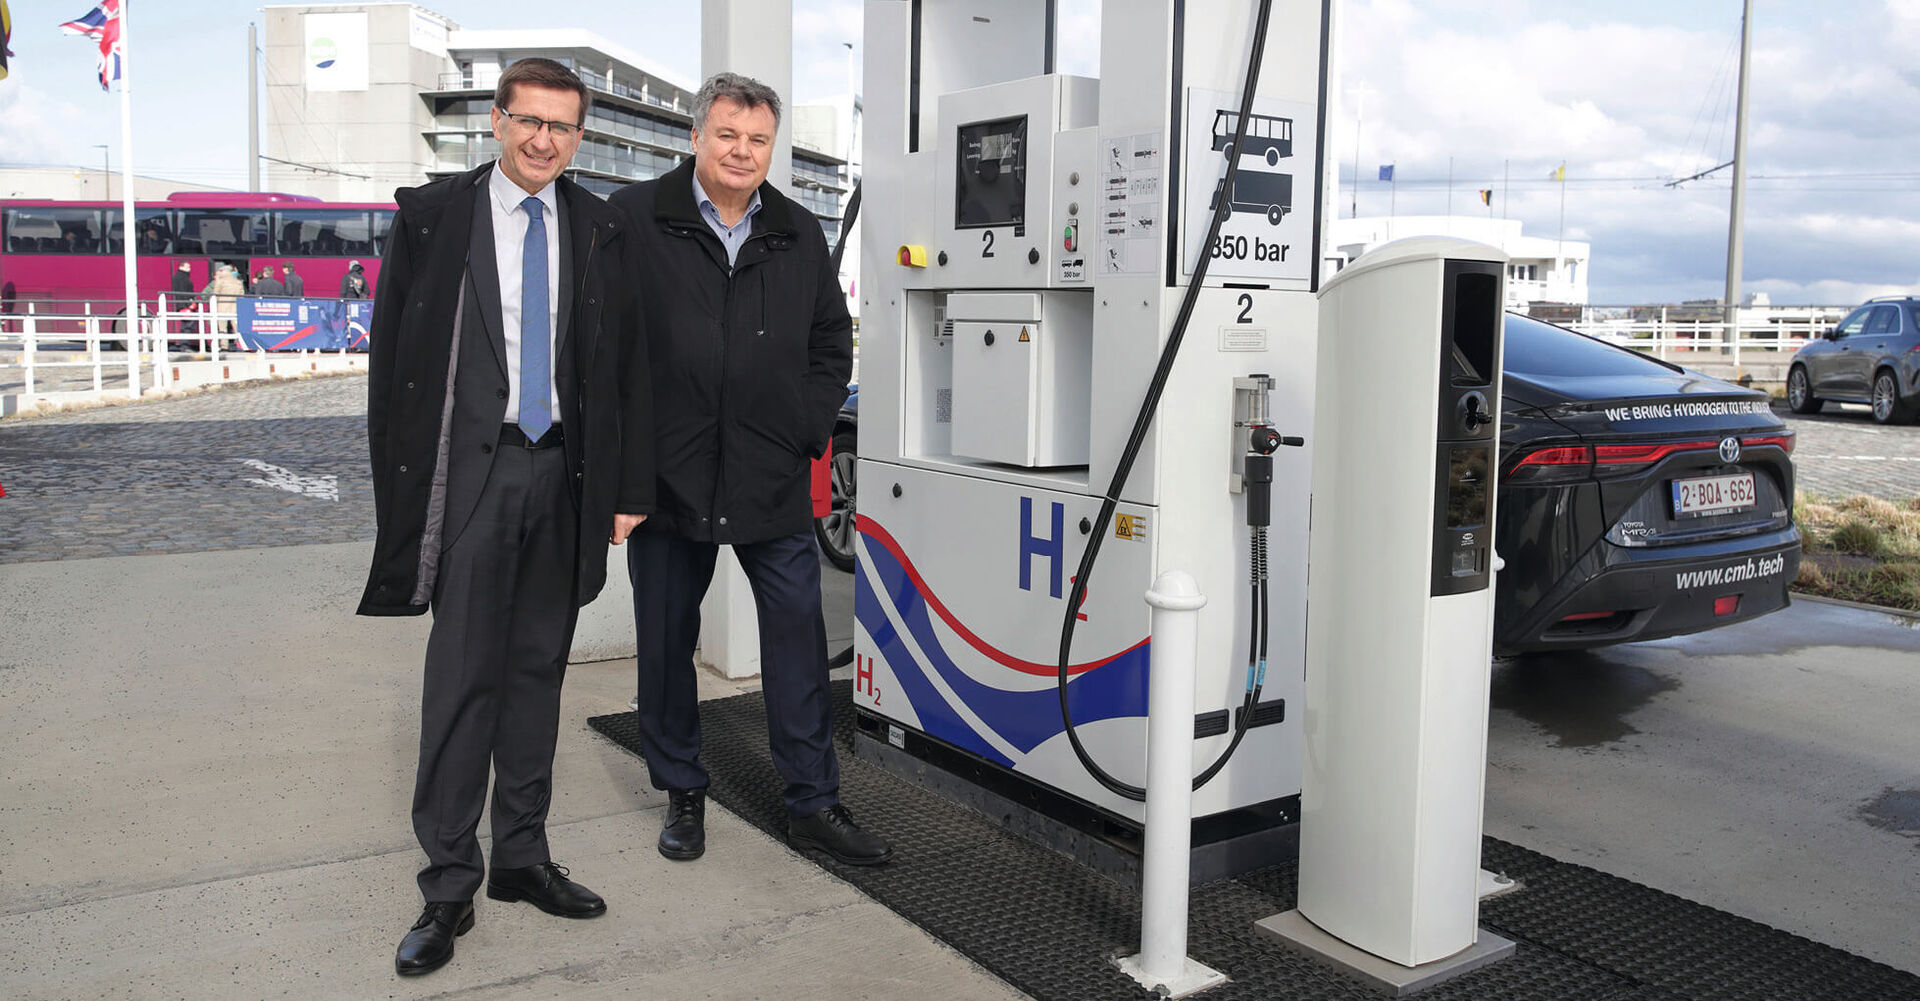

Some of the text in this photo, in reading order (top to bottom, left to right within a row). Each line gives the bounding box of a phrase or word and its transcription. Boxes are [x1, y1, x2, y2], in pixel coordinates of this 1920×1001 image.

[982, 230, 994, 258] 2
[1254, 236, 1290, 262] bar
[1236, 293, 1253, 324] 2
[1605, 407, 1631, 422] WE
[1632, 403, 1671, 420] BRING
[1673, 401, 1728, 418] HYDROGEN
[1727, 401, 1739, 415] TO
[1738, 401, 1753, 415] THE
[1621, 528, 1656, 537] MIRAI
[1622, 521, 1644, 529] TOYOTA
[1676, 553, 1784, 589] www.cmb.tech
[857, 653, 881, 706] H2
